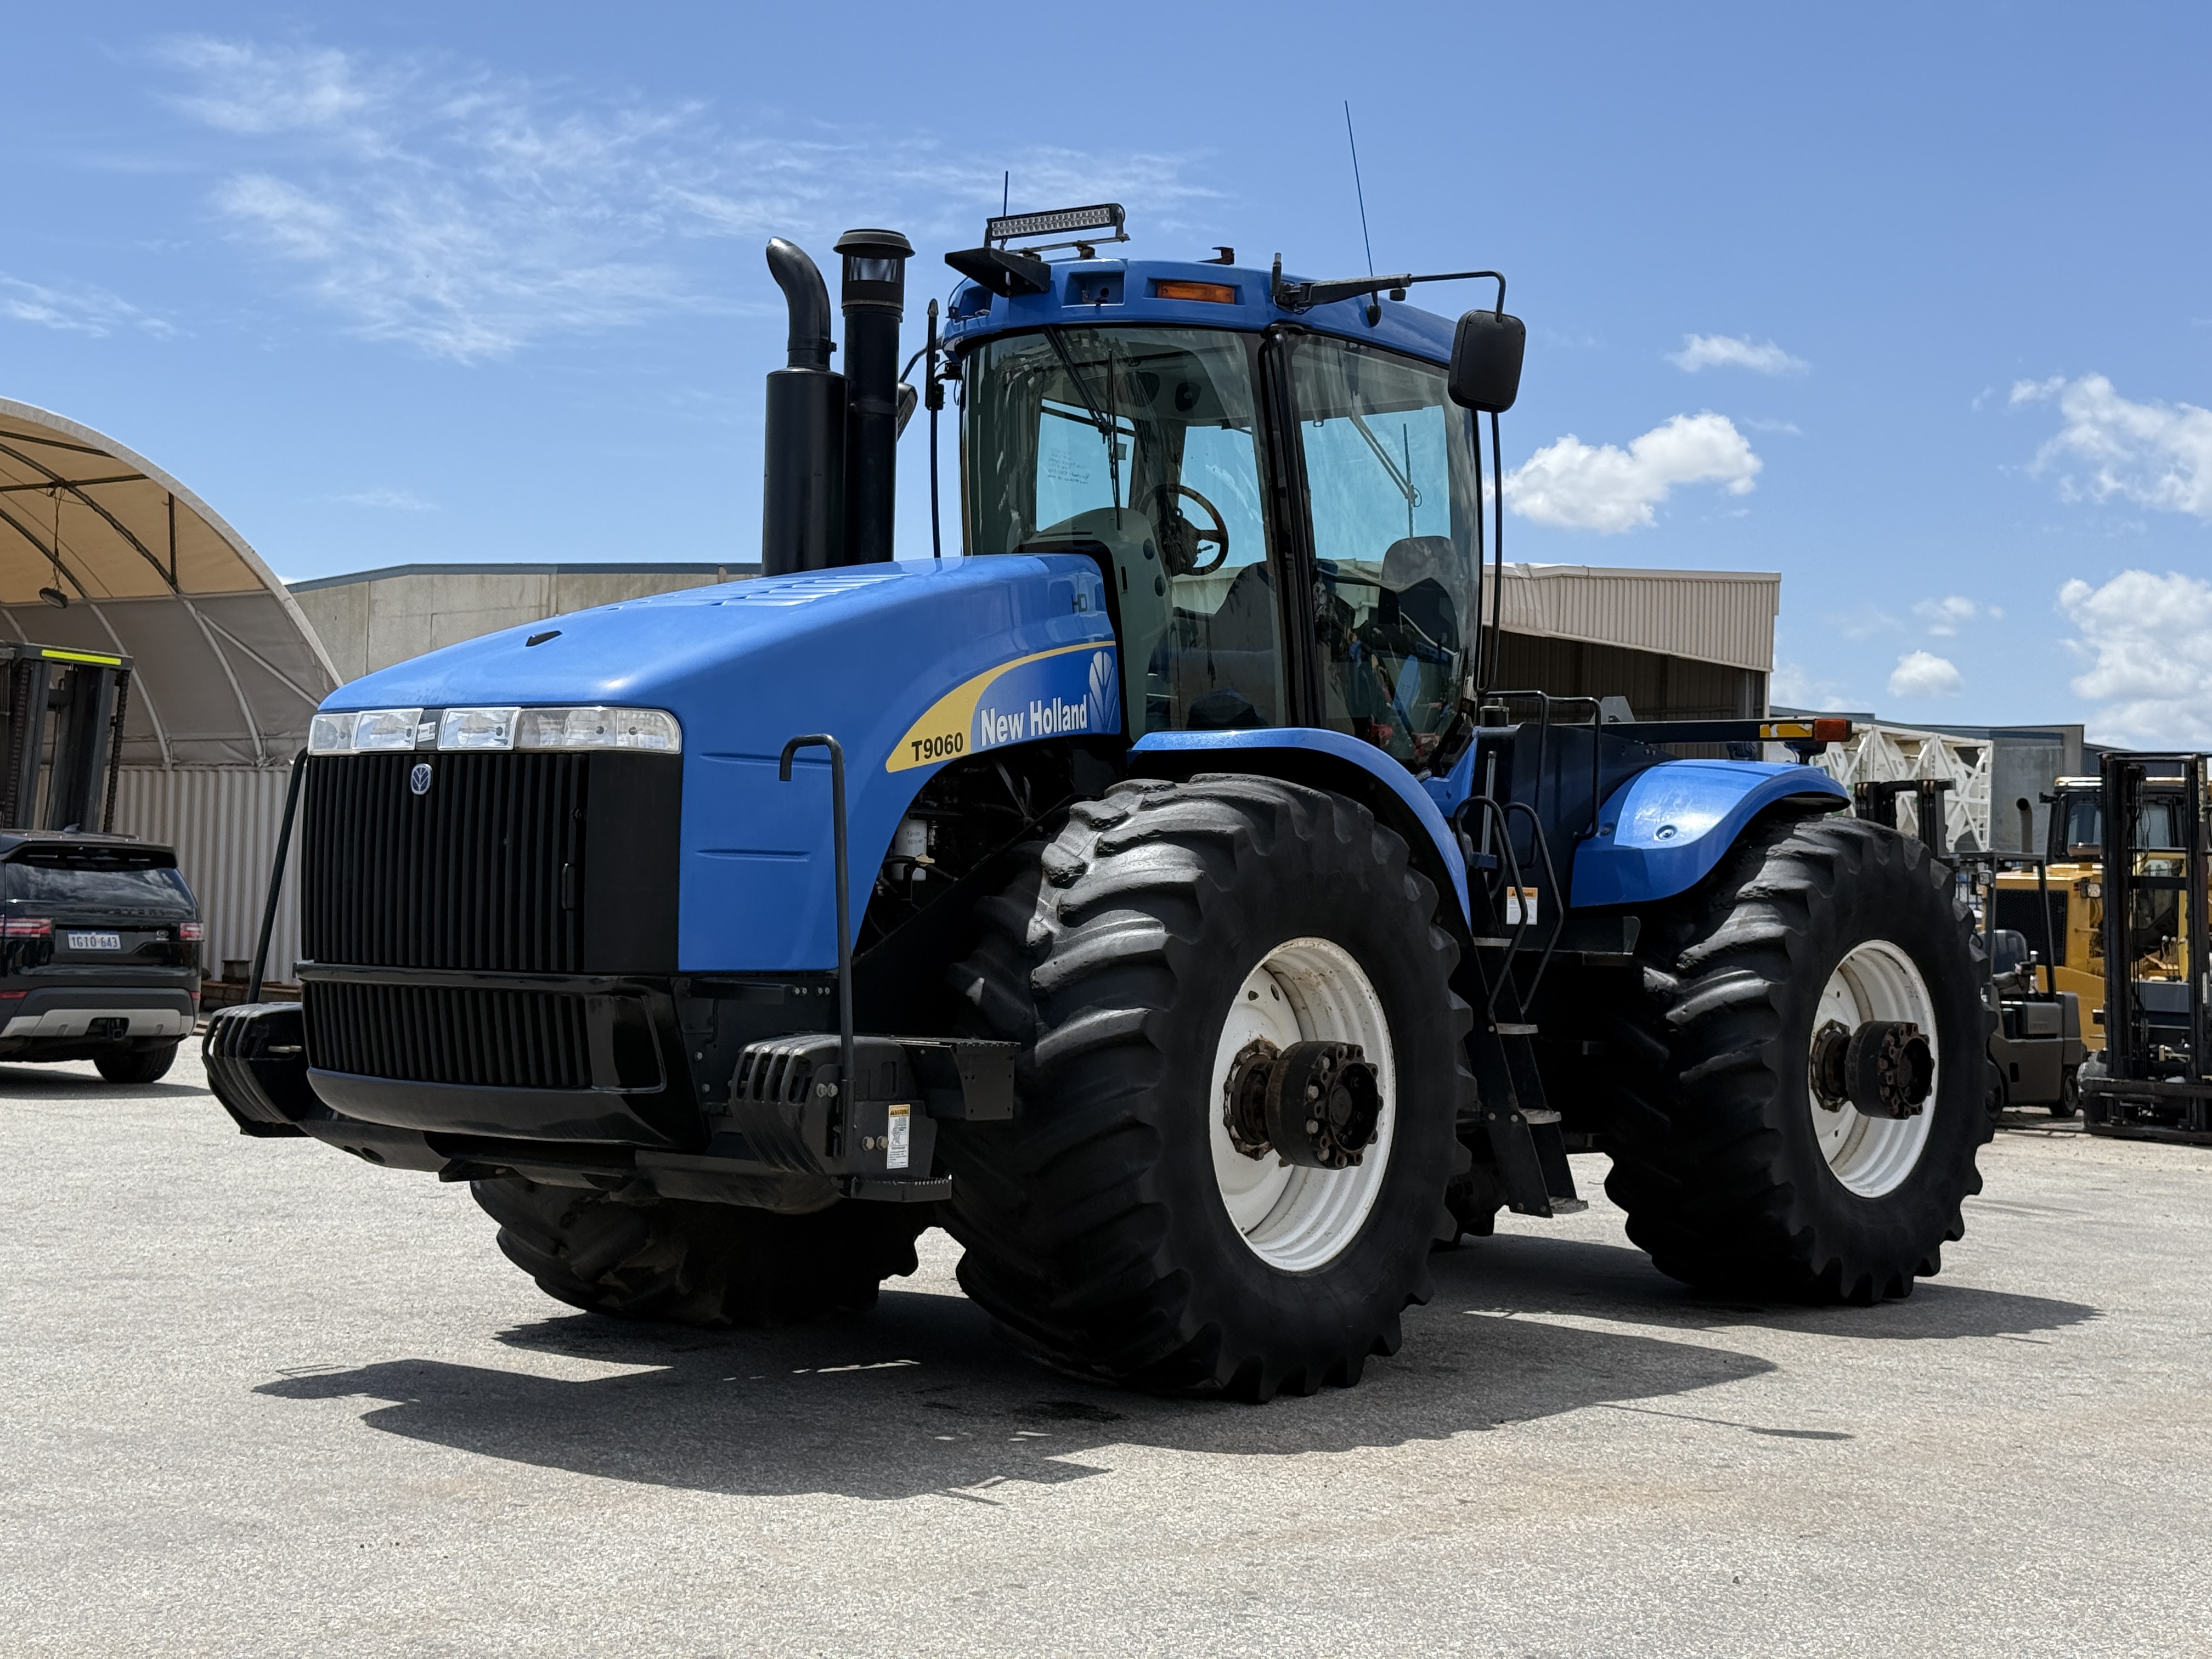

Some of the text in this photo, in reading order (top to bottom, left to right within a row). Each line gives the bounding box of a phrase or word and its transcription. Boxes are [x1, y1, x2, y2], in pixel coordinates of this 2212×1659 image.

[980, 694, 1088, 746] New Holland
[911, 732, 963, 762] T9060
